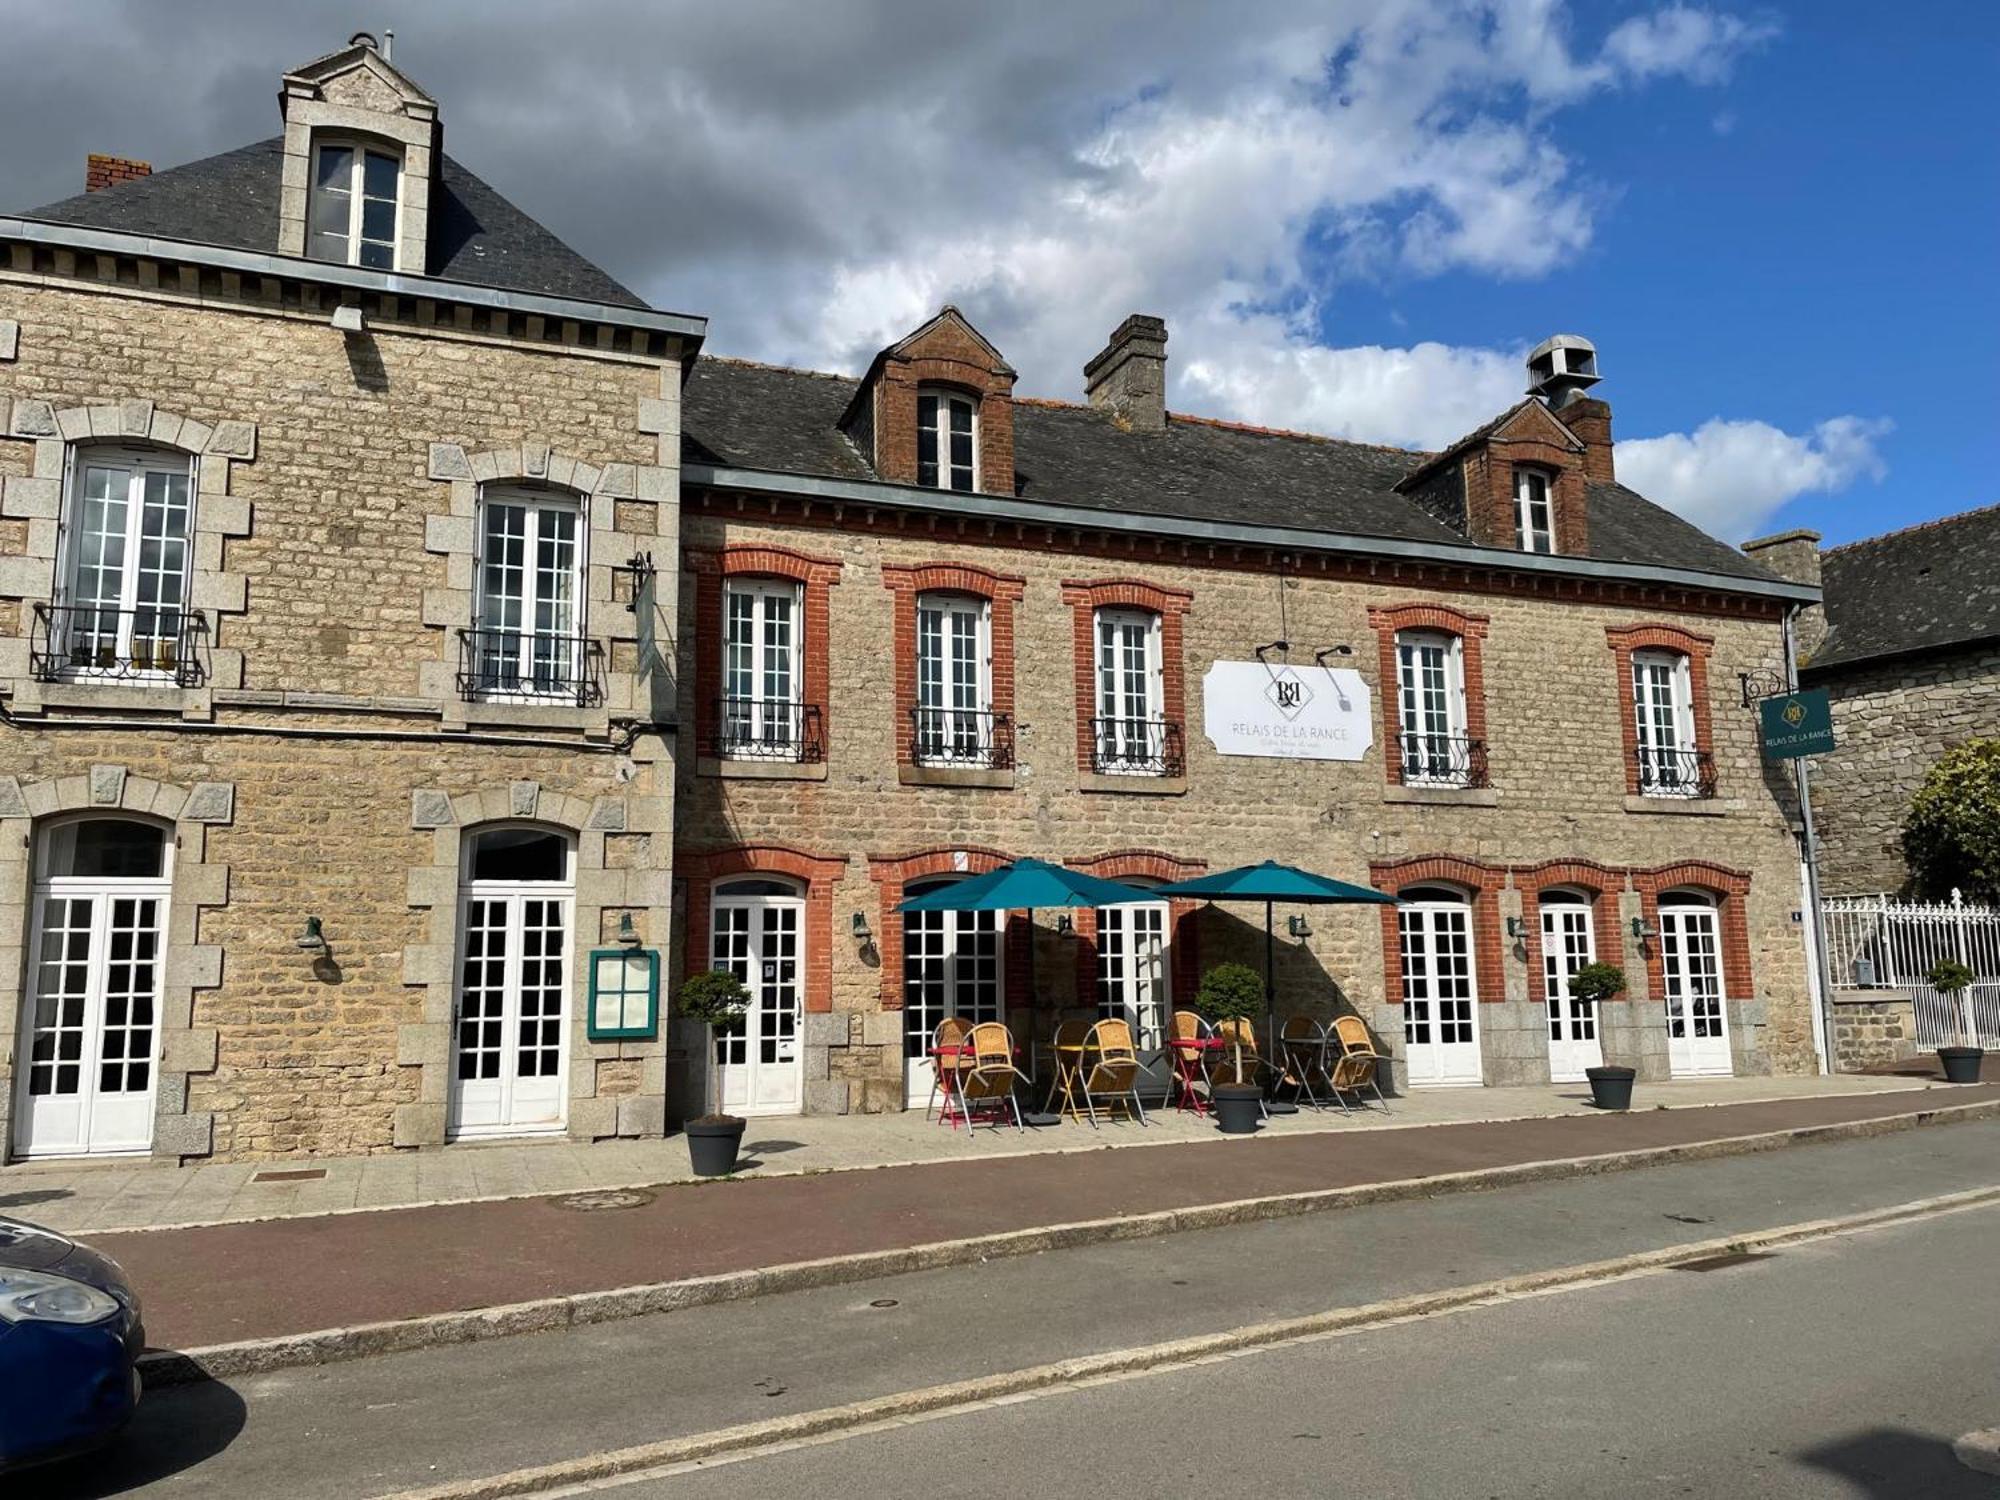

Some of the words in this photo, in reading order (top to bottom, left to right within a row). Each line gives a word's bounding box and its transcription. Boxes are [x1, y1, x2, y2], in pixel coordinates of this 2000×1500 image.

[1232, 723, 1270, 737] RELAIS
[1273, 725, 1290, 738] DE
[1292, 726, 1307, 738] LA
[1310, 727, 1349, 741] RANCE
